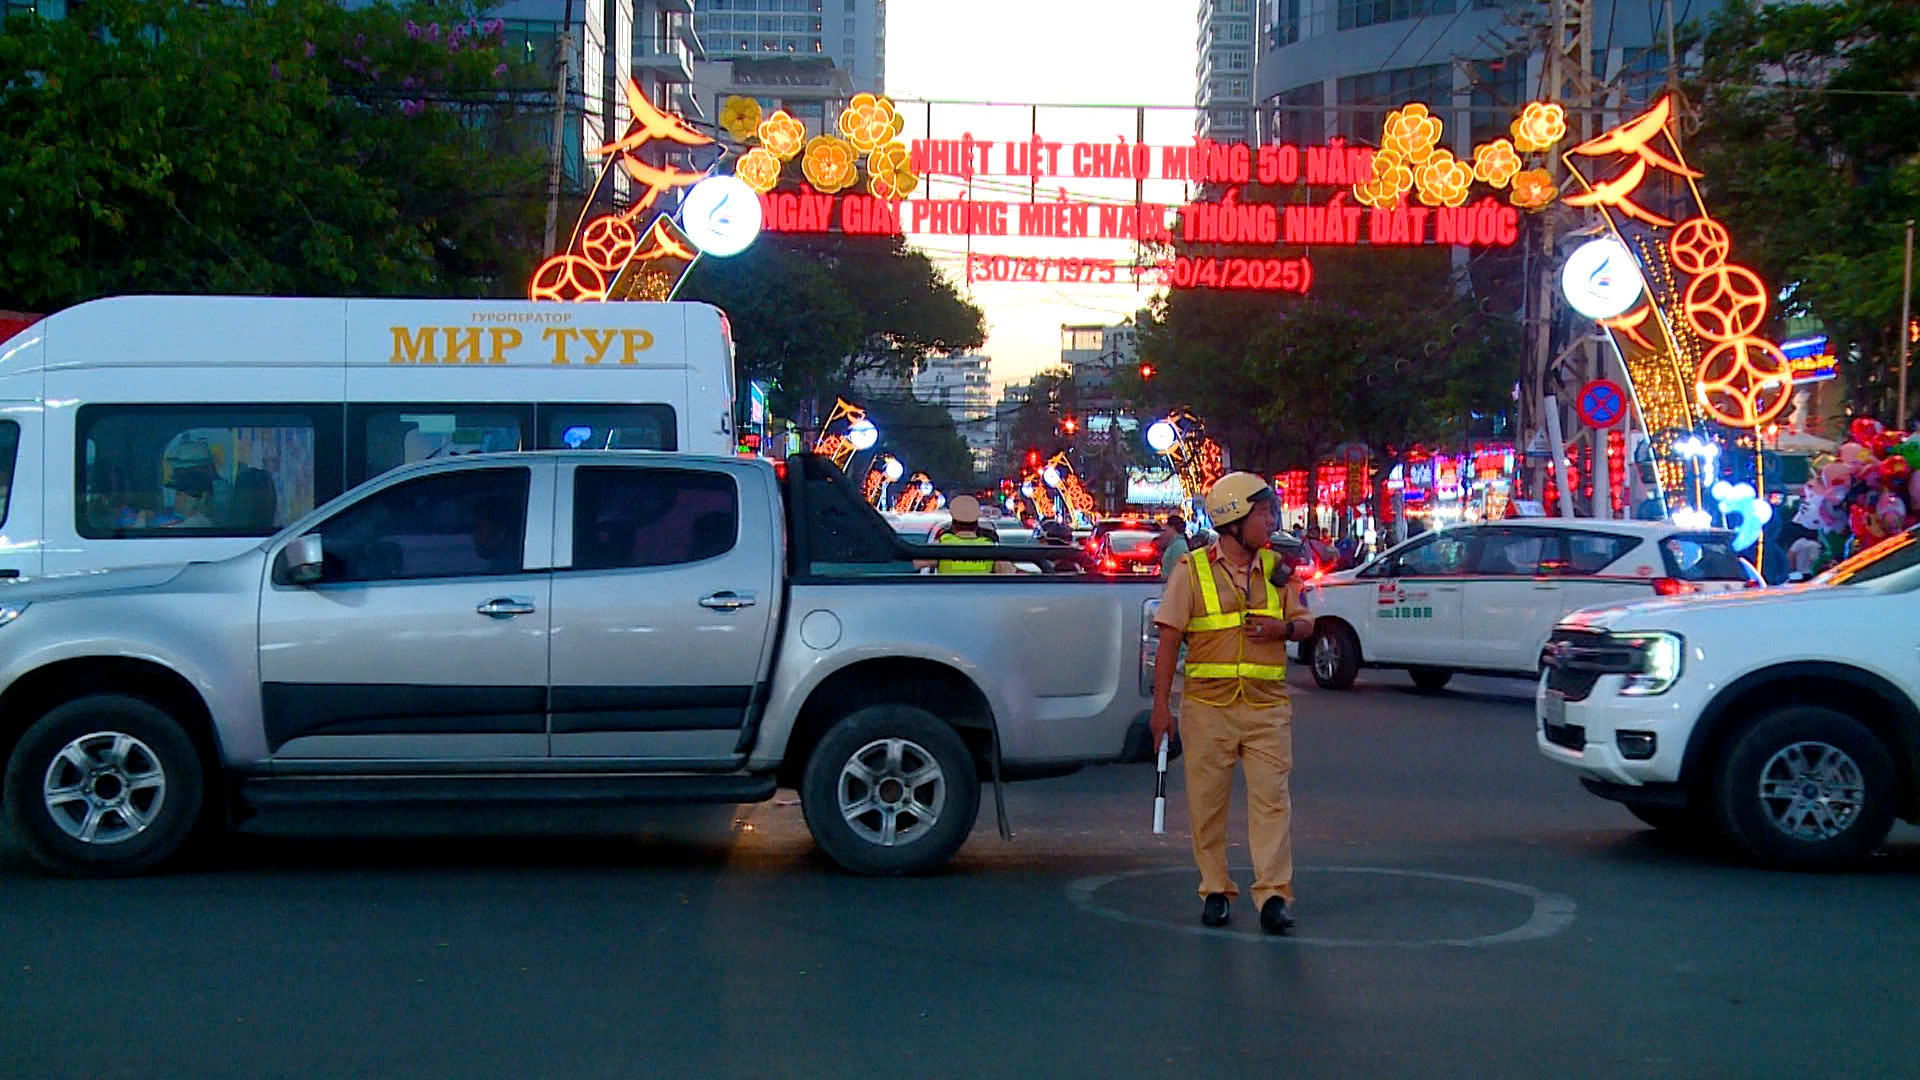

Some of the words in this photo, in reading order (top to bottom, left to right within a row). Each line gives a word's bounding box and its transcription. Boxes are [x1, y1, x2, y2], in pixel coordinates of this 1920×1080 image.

[911, 131, 994, 181] NHIỆT
[1006, 133, 1063, 183] LIỆT
[1073, 134, 1150, 180] CHÀO
[1162, 133, 1249, 182] MỪNG
[1258, 143, 1298, 184] 50
[1307, 135, 1374, 184] NĂM
[761, 182, 834, 232] NGÀY
[842, 176, 901, 234] GIẢI
[912, 190, 1008, 236] PHÓNG
[1019, 186, 1088, 238] MIỀN
[1099, 201, 1172, 244] NAM,
[1179, 187, 1277, 244] THỐNG
[1286, 191, 1362, 244] NHẤT
[1370, 190, 1428, 244] ĐẤT
[1436, 196, 1518, 246] NƯỚC
[967, 252, 1115, 284] (30/4/1975
[1157, 256, 1312, 295] 30/4/2025)
[471, 312, 572, 323] ТУРОПЕРАТОР
[389, 327, 523, 364] МИР
[542, 327, 654, 365] ТУР
